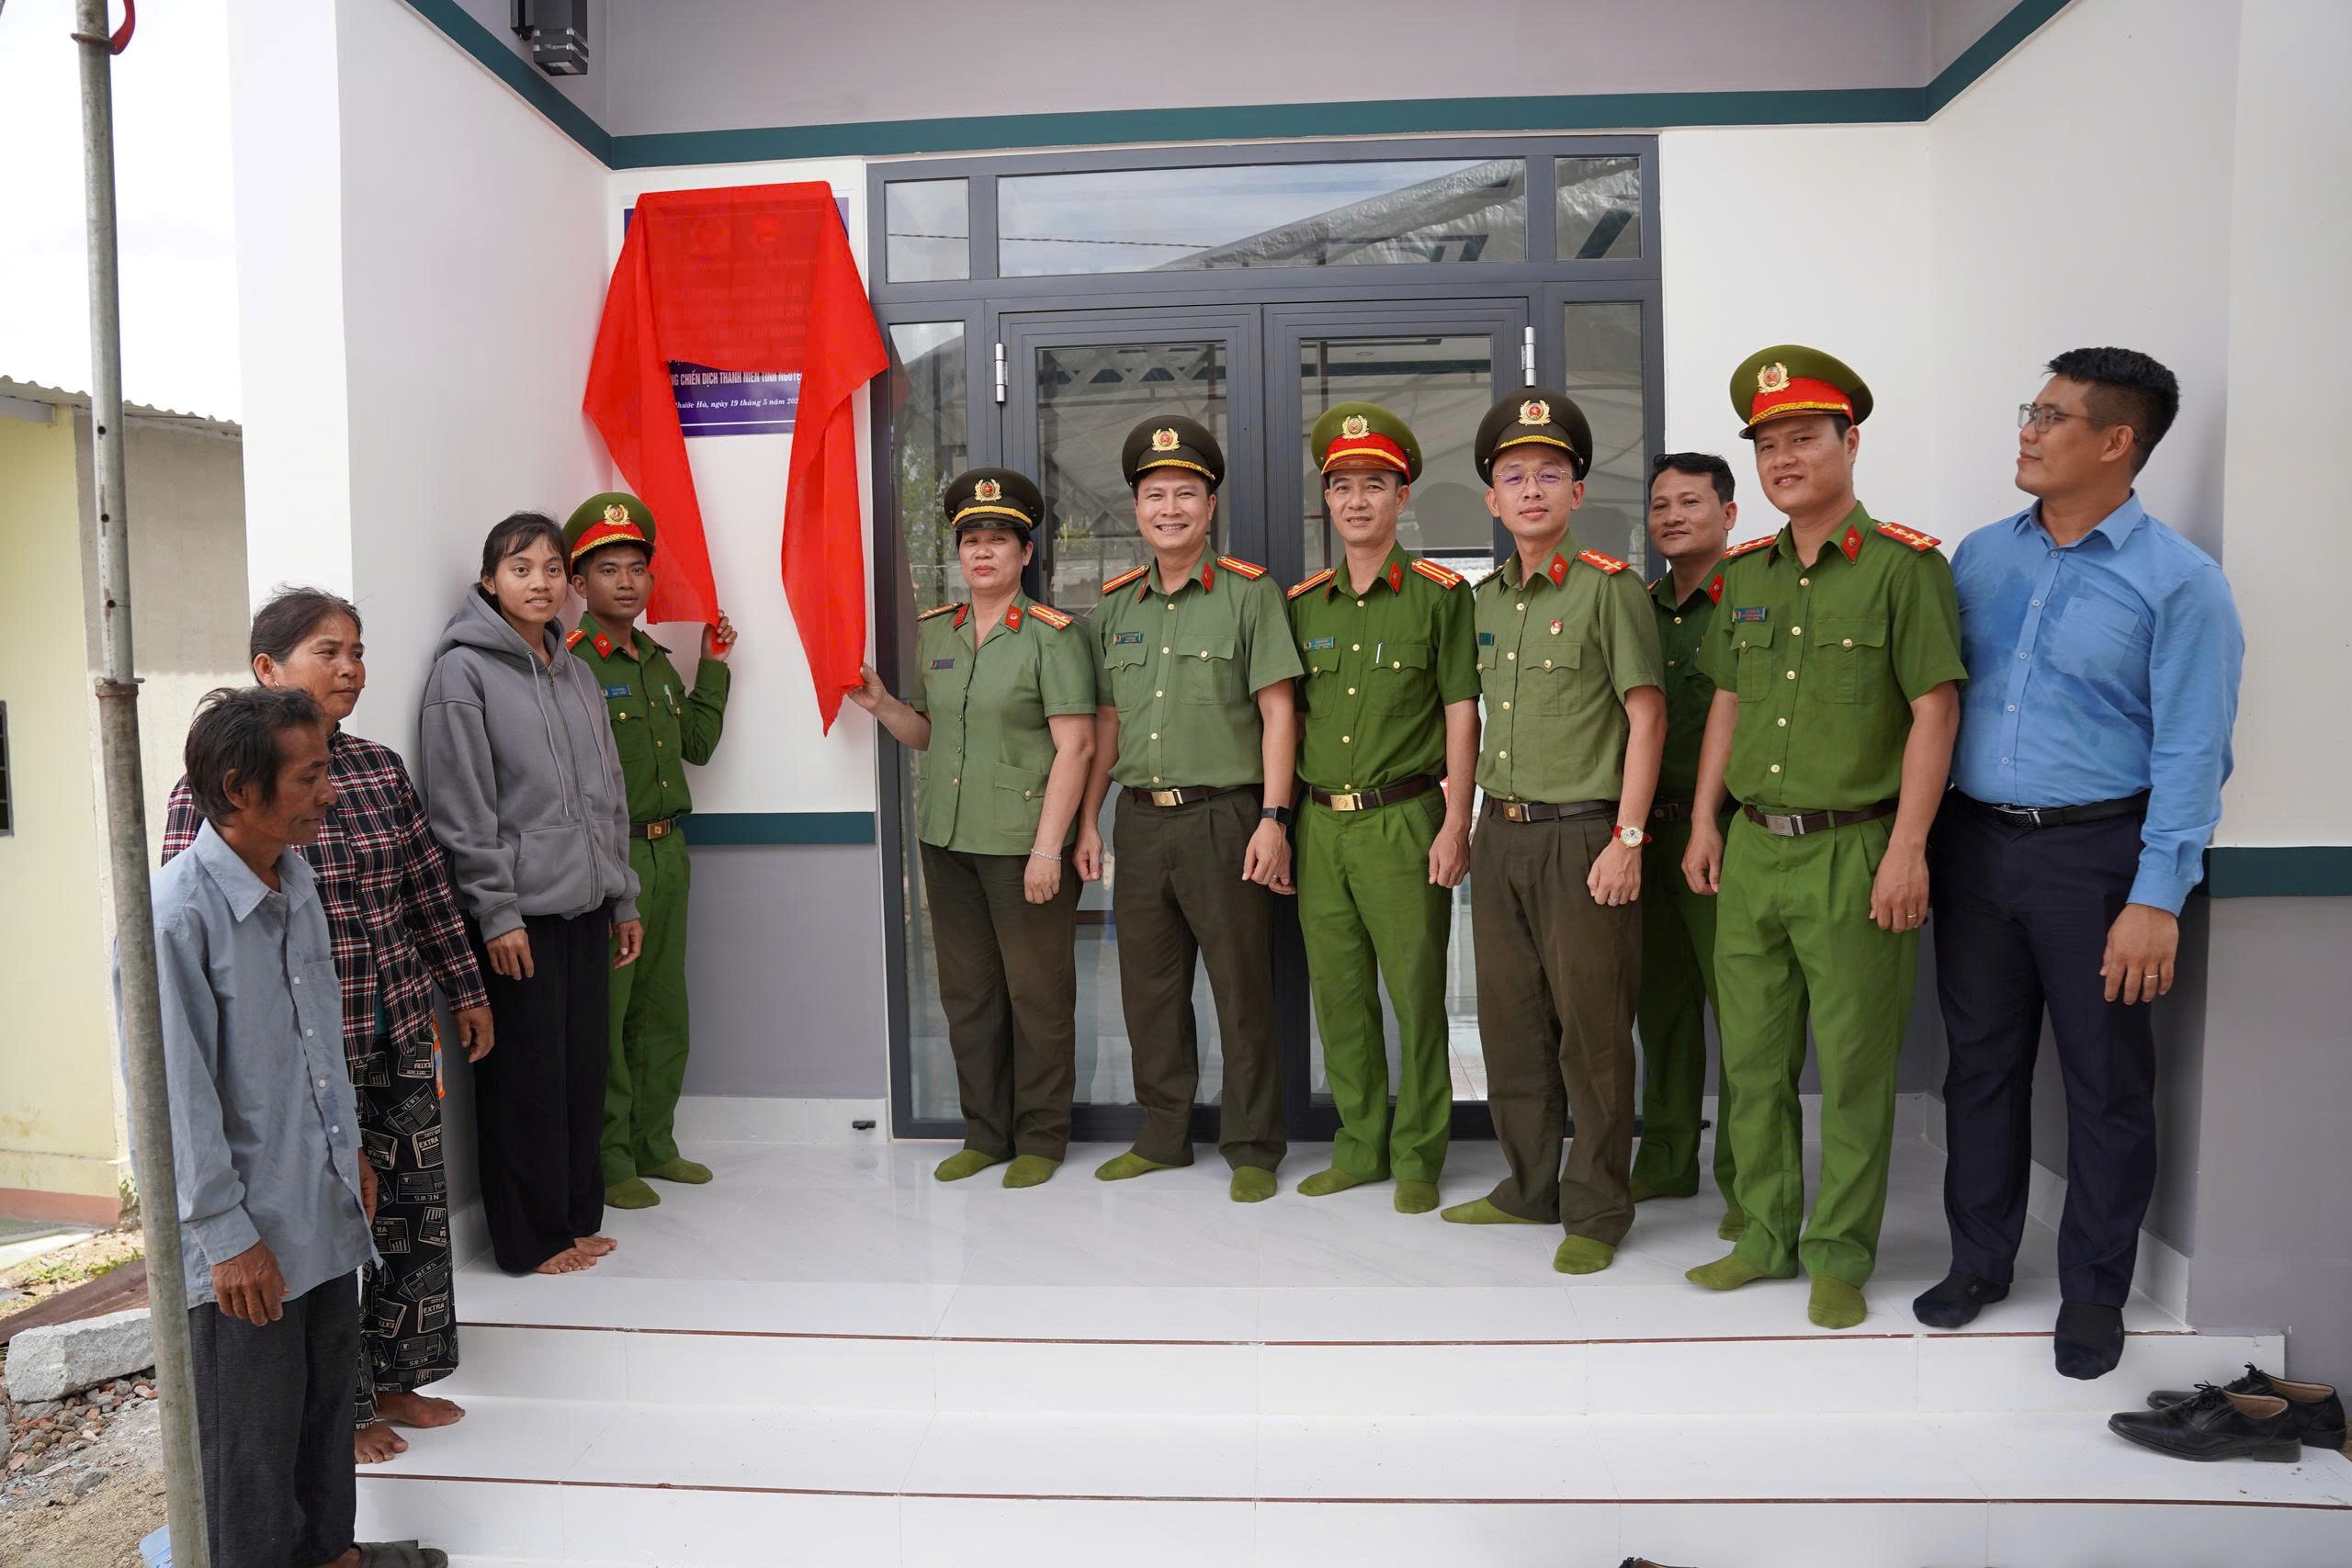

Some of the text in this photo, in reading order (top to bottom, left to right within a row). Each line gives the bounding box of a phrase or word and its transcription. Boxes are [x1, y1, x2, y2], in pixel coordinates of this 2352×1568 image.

[680, 369, 701, 386] CHIẾN
[702, 372, 718, 388] DỊCH
[719, 371, 741, 384] THANH
[695, 400, 709, 409] Hà,
[710, 400, 729, 409] ngày
[740, 399, 762, 407] tháng
[401, 1095, 420, 1111] NEWS
[419, 1136, 439, 1148] EXTRA
[416, 1262, 437, 1278] NEWS
[423, 1303, 445, 1314] EXTRA
